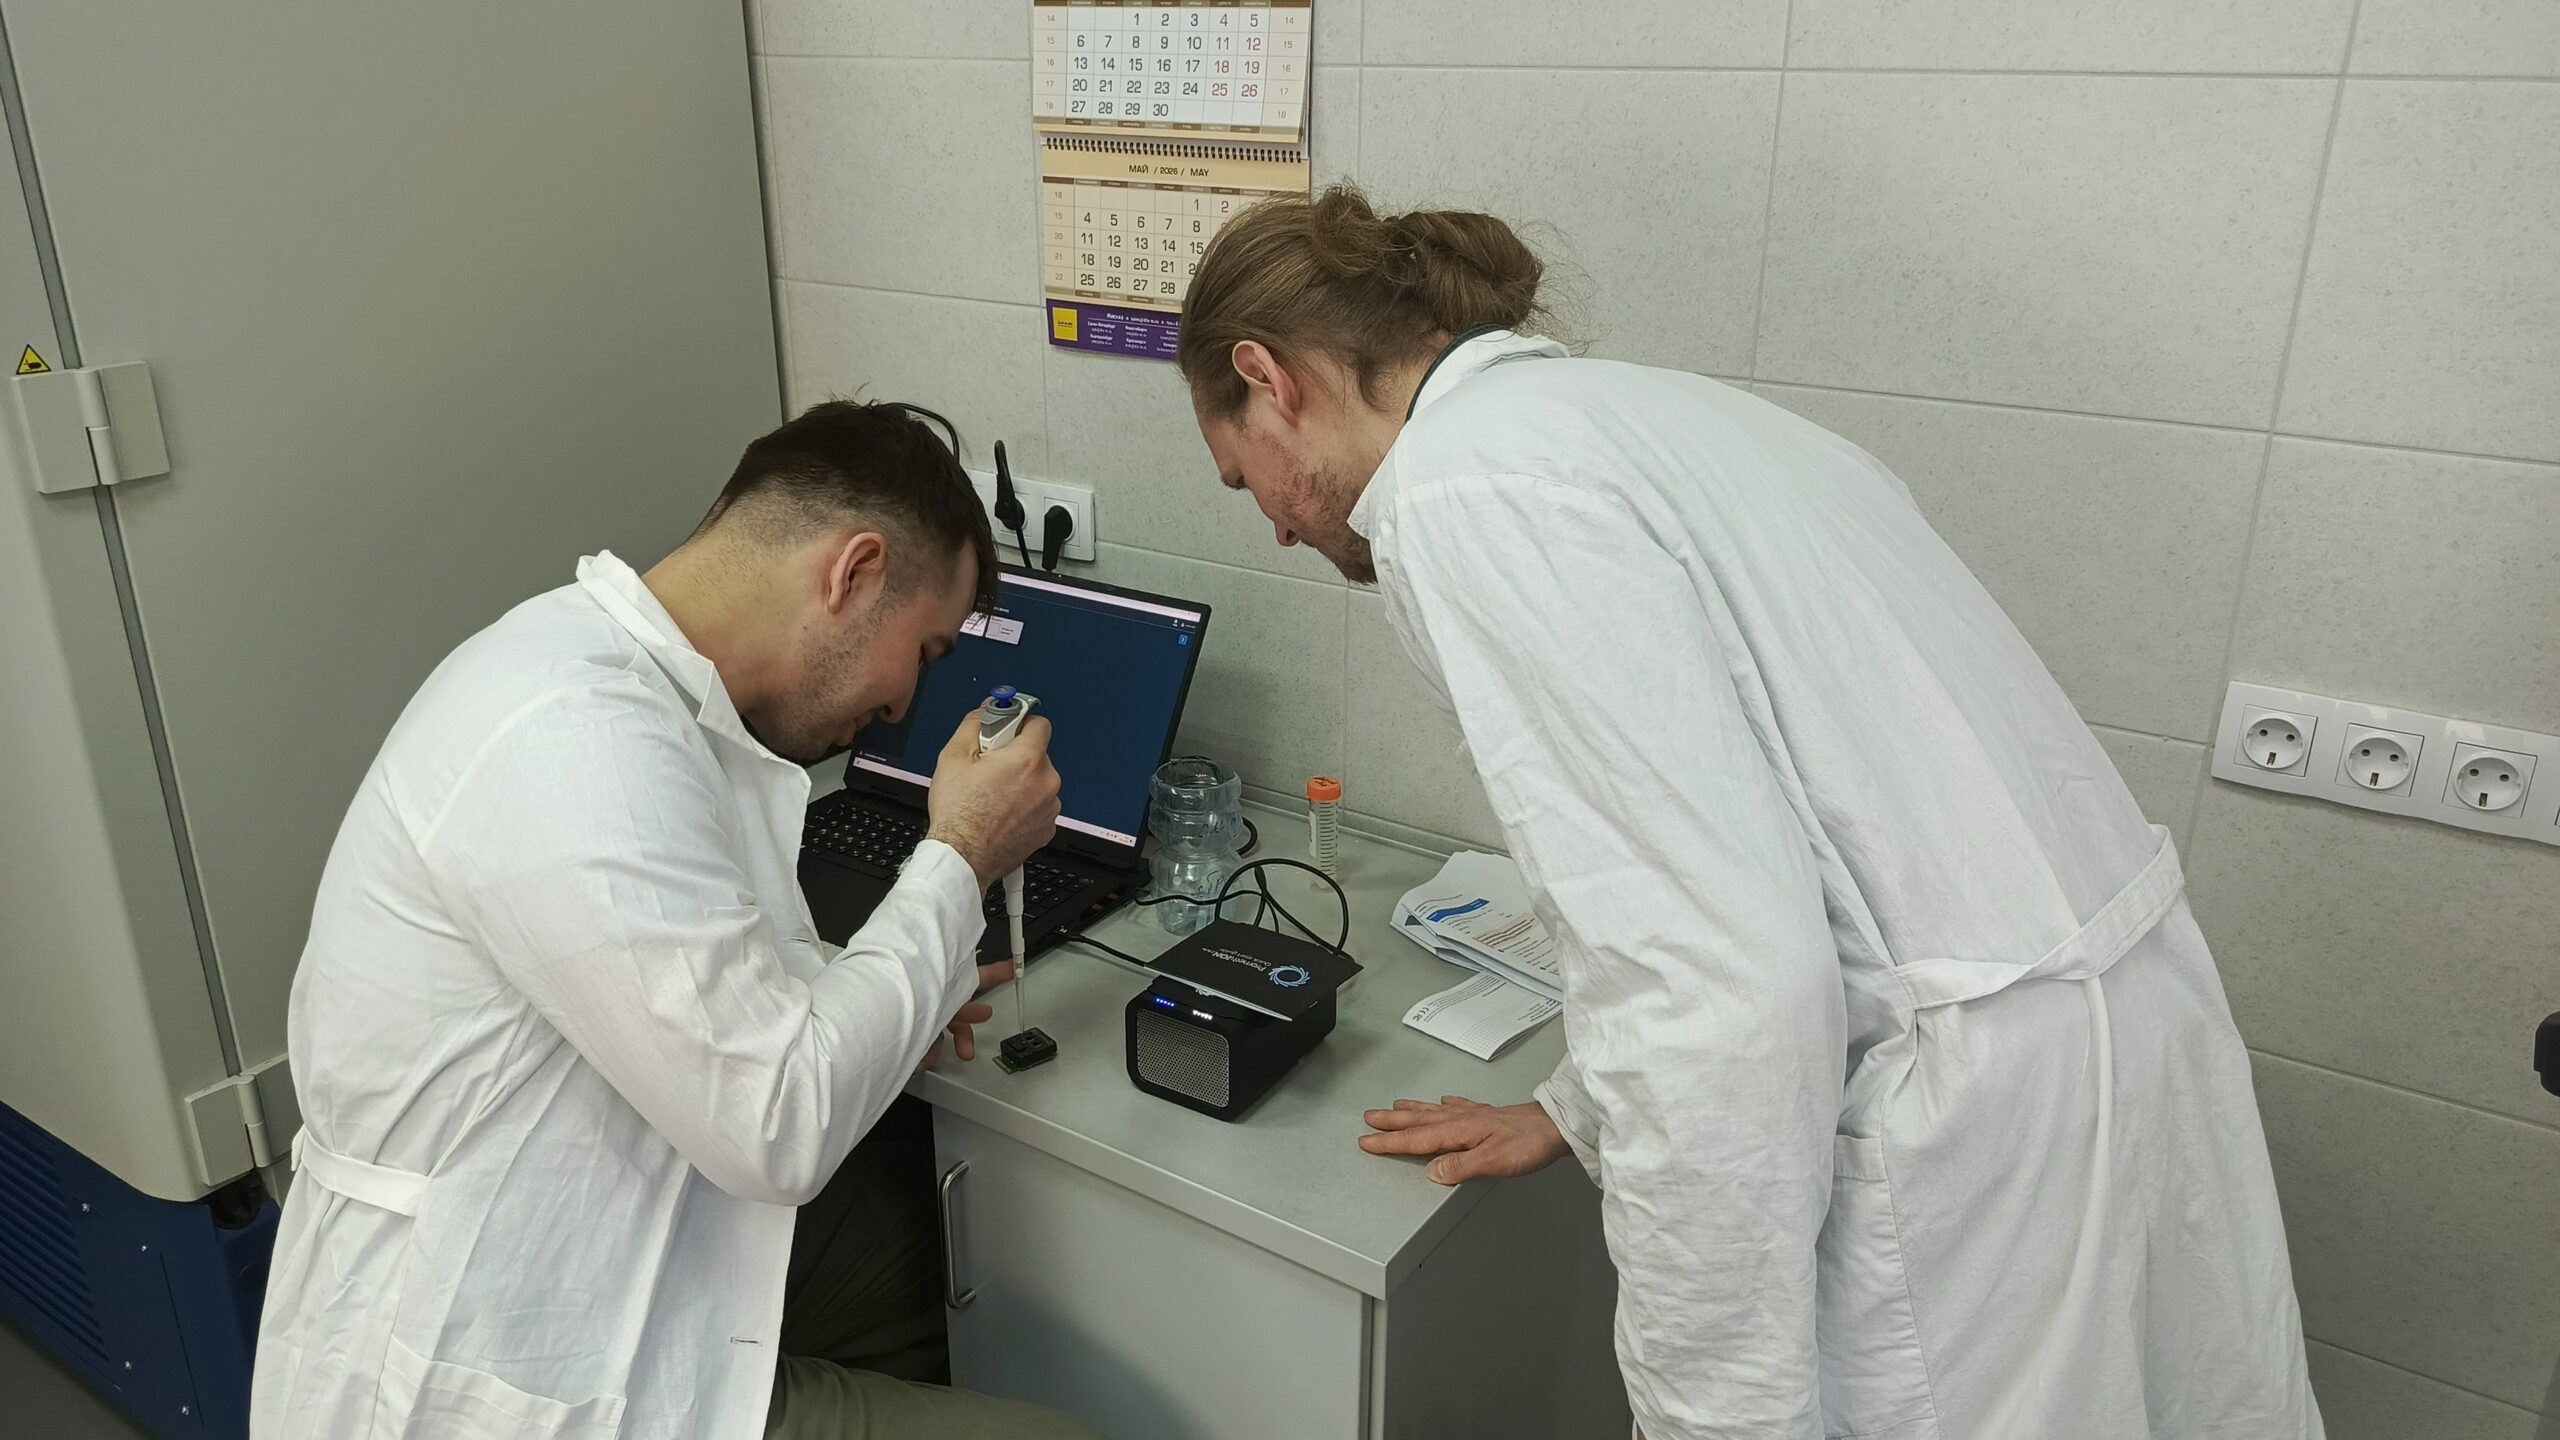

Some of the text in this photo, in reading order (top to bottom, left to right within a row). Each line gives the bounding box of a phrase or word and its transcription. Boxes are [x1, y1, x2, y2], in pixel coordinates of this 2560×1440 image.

[1134, 13, 1140, 26] 1
[1161, 13, 1170, 26] 2
[1190, 13, 1199, 27] 3
[1219, 13, 1228, 27] 4
[1250, 14, 1259, 27] 5
[1077, 35, 1085, 48] 6
[1104, 35, 1112, 48] 7
[1132, 36, 1140, 48] 8
[1160, 36, 1169, 49] 9
[1186, 36, 1202, 50] 10
[1216, 37, 1229, 50] 11
[1246, 37, 1261, 51] 12
[1074, 57, 1088, 70] 13
[1101, 57, 1115, 70] 14
[1128, 58, 1143, 71] 15
[1156, 59, 1171, 72] 16
[1185, 59, 1200, 73] 17
[1214, 60, 1230, 73] 18
[1244, 61, 1260, 74] 19
[1072, 78, 1088, 91] 20
[1099, 79, 1113, 92] 21
[1126, 80, 1141, 93] 22
[1154, 81, 1170, 94] 23
[1182, 82, 1198, 95] 24
[1211, 83, 1228, 96] 25
[1241, 84, 1258, 97] 26
[1071, 100, 1086, 113] 27
[1098, 101, 1113, 114] 28
[1125, 103, 1140, 115] 29
[1152, 103, 1169, 117] 30
[1128, 164, 1149, 174] МАЙ
[1159, 167, 1178, 175] 2026
[1190, 168, 1209, 177] MAY
[1194, 199, 1199, 211] 1
[1221, 200, 1229, 213] 2
[1083, 212, 1091, 224] 4
[1110, 214, 1118, 226] 5
[1137, 216, 1145, 228] 6
[1164, 218, 1172, 230] 7
[1192, 220, 1201, 233] 8
[1081, 233, 1093, 245] 11
[1107, 235, 1121, 247] 12
[1134, 237, 1148, 250] 13
[1162, 239, 1176, 252] 14
[1189, 242, 1204, 254] 15
[1081, 253, 1095, 266] 18
[1107, 256, 1121, 268] 19
[1133, 258, 1149, 271] 20
[1161, 260, 1174, 273] 21
[1080, 273, 1095, 286] 25
[1106, 276, 1121, 289] 26
[1133, 279, 1148, 291] 27
[1160, 281, 1176, 294] 28
